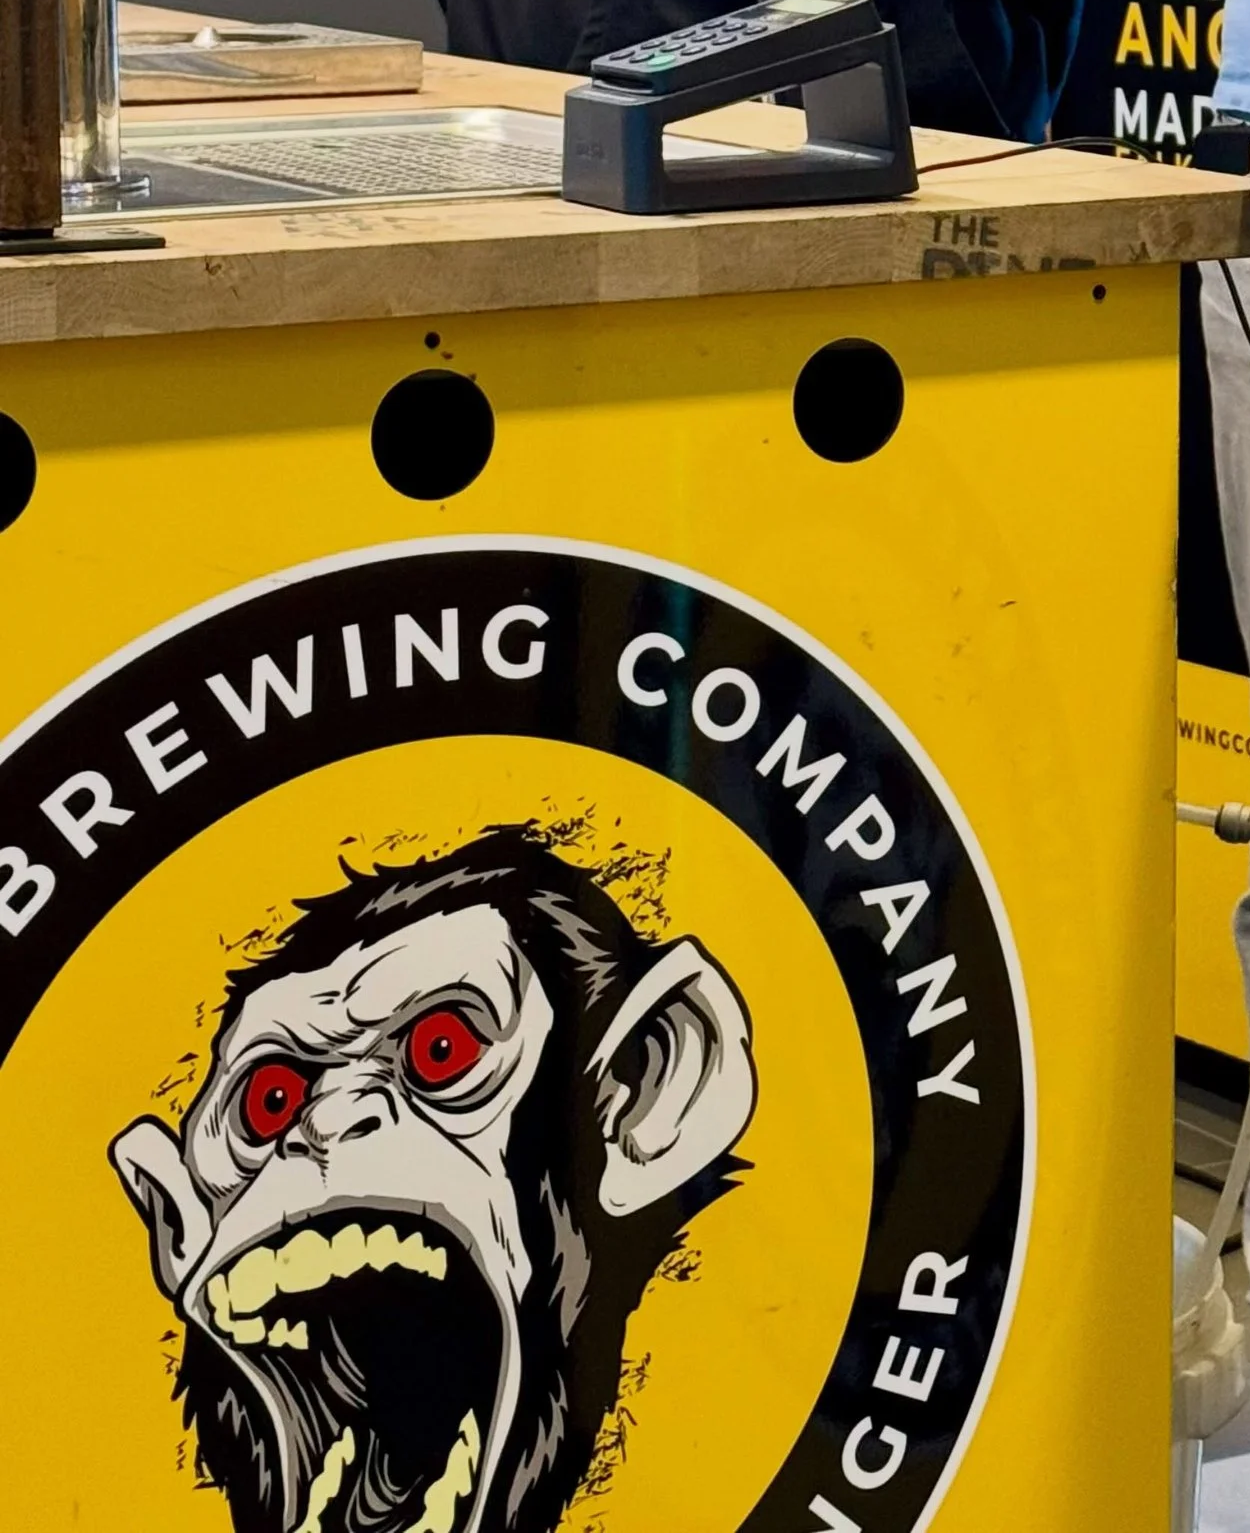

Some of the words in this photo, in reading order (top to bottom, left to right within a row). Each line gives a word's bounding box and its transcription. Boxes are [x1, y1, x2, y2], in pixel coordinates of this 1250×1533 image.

[928, 213, 1000, 247] THE
[0, 604, 551, 938] BREWING
[616, 631, 982, 1108] COMPANY
